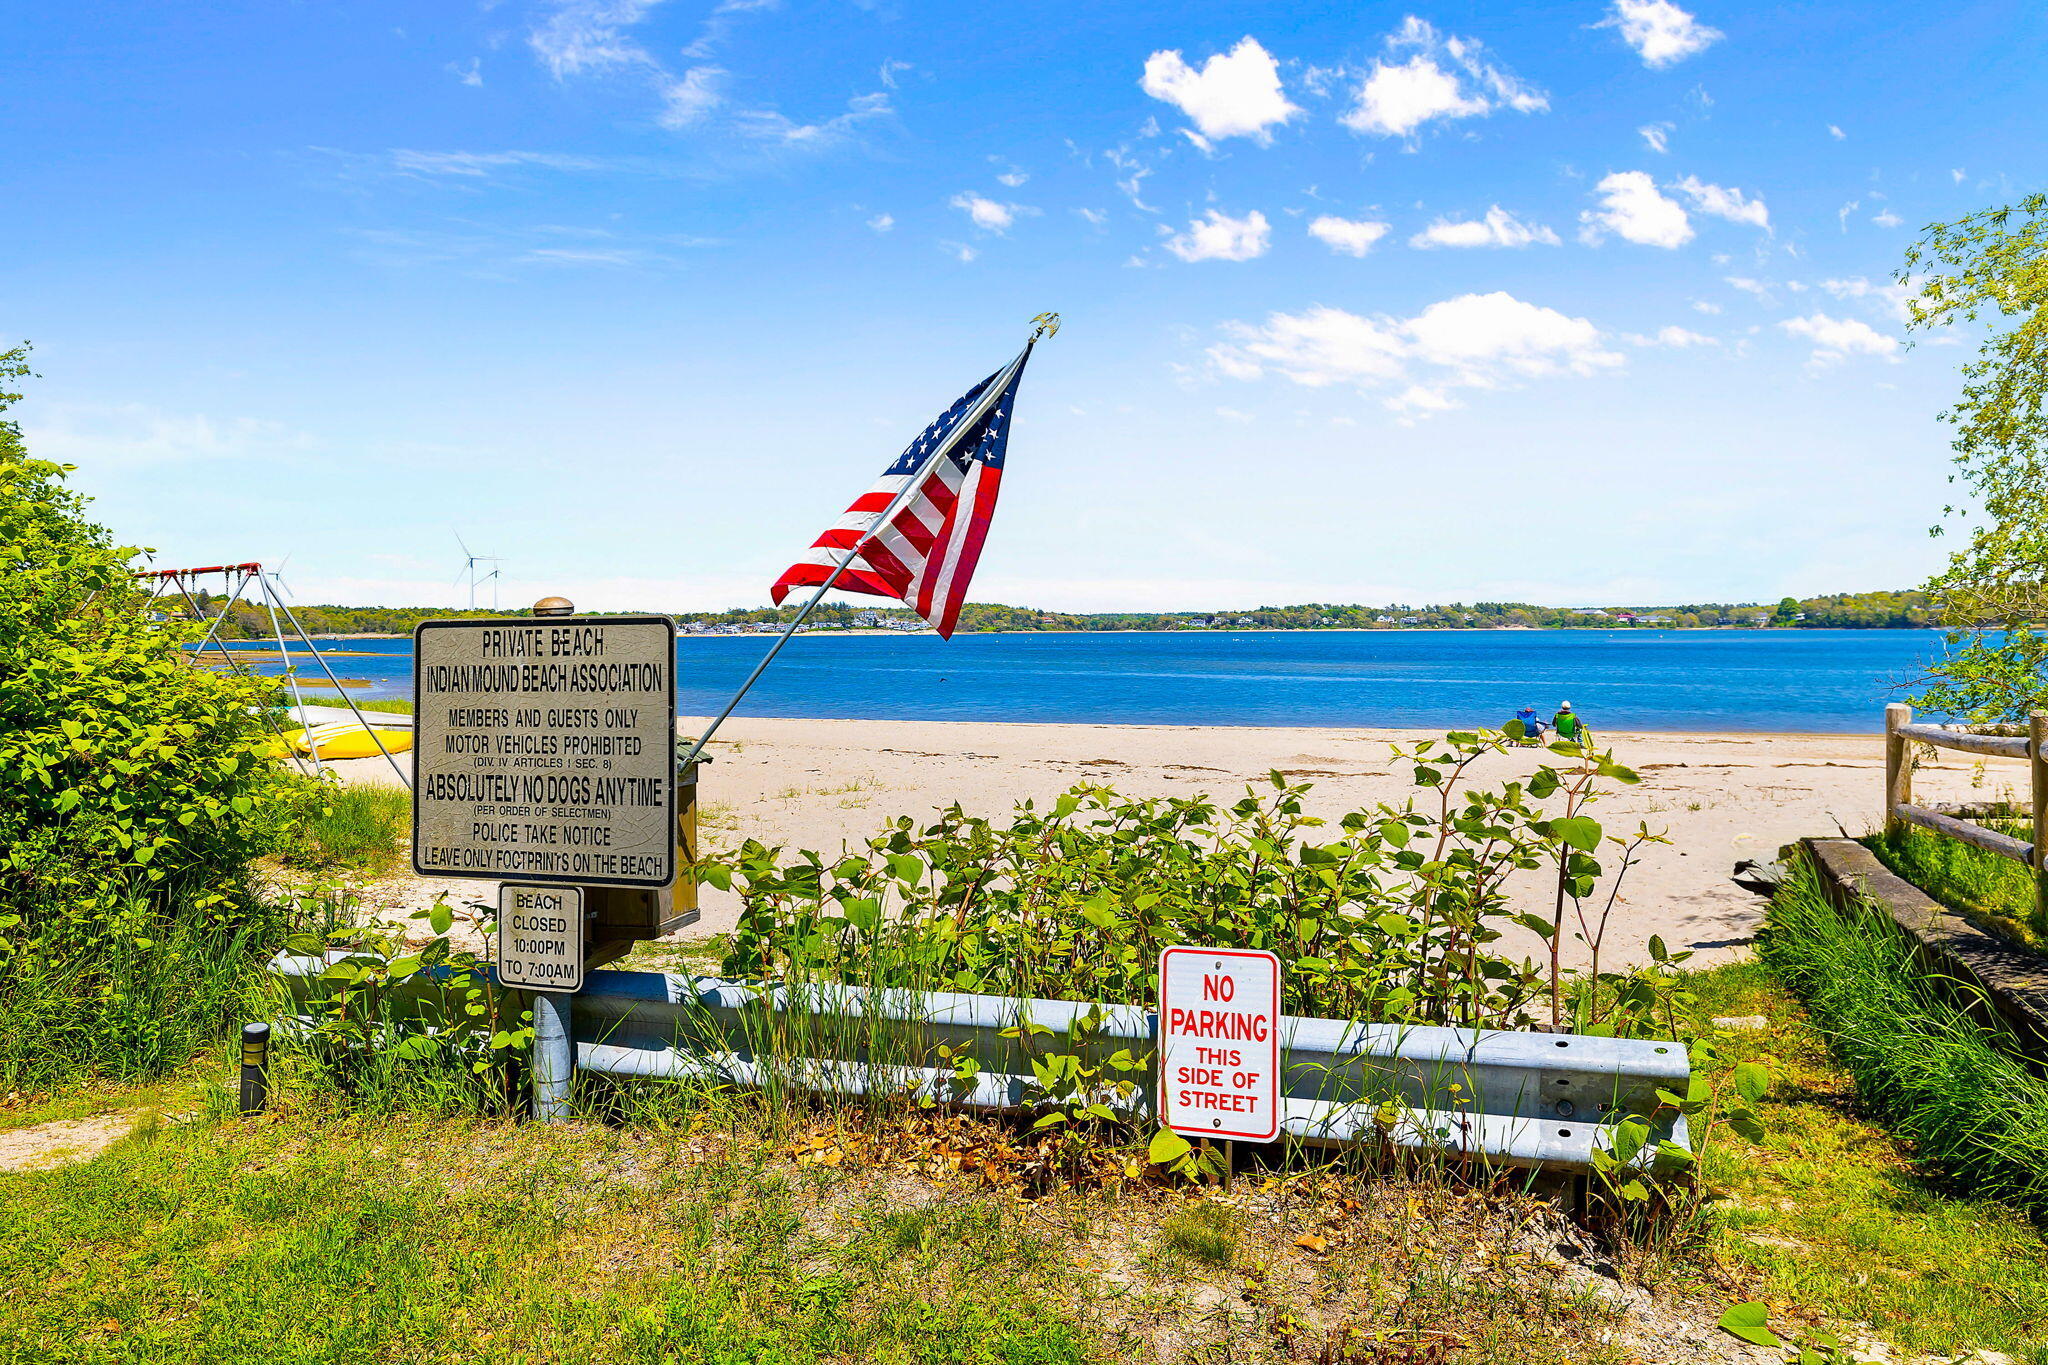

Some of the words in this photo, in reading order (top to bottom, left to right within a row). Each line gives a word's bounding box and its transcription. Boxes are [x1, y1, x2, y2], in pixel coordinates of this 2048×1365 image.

[482, 629, 543, 657] PRIVATE
[551, 628, 604, 656] BEACH
[427, 665, 470, 693] INDIAN
[473, 664, 519, 693] MOUND
[523, 664, 567, 692] BEACH
[570, 663, 662, 692] ASSOCIATION
[449, 709, 509, 728] MEMBERS
[515, 709, 541, 728] AND
[548, 709, 599, 728] GUESTS
[605, 709, 638, 729] ONLY
[445, 734, 489, 753] MOTOR
[496, 735, 558, 754] VEHICLES
[564, 736, 642, 756] PROHIBITED
[473, 757, 494, 768] (DIV.
[499, 757, 508, 767] IV
[513, 758, 563, 768] ARTICLES
[575, 759, 598, 769] SEC.
[603, 759, 612, 771] 8)
[426, 773, 520, 801] ABSOLUTELY
[523, 775, 544, 803] NO
[550, 776, 590, 805] DOGS
[595, 777, 663, 807] ANYTIME
[473, 805, 495, 817] (PER
[499, 806, 531, 817] ORDER
[534, 806, 547, 817] OF
[551, 807, 611, 821] SELECTMEN)
[473, 822, 518, 843] POLICE
[524, 824, 557, 844] TAKE
[563, 826, 611, 846] NOTICE
[424, 847, 460, 867] LEAVE
[464, 848, 493, 868] ONLY
[496, 849, 569, 872] FOOTPRINTS
[573, 852, 590, 873] ON
[594, 854, 617, 874] THE
[621, 855, 662, 877] BEACH
[516, 893, 562, 910] BEACH
[512, 915, 567, 933] CLOSED
[514, 938, 565, 956] 10:00PM
[505, 960, 522, 975] TO
[528, 962, 575, 979] 7:00AM
[1203, 973, 1235, 1002] NO
[1170, 1008, 1268, 1043] PARKING
[1195, 1046, 1241, 1067] THIS
[1177, 1066, 1223, 1087] SIDE
[1232, 1071, 1260, 1089] OF
[1178, 1090, 1258, 1114] STREET
